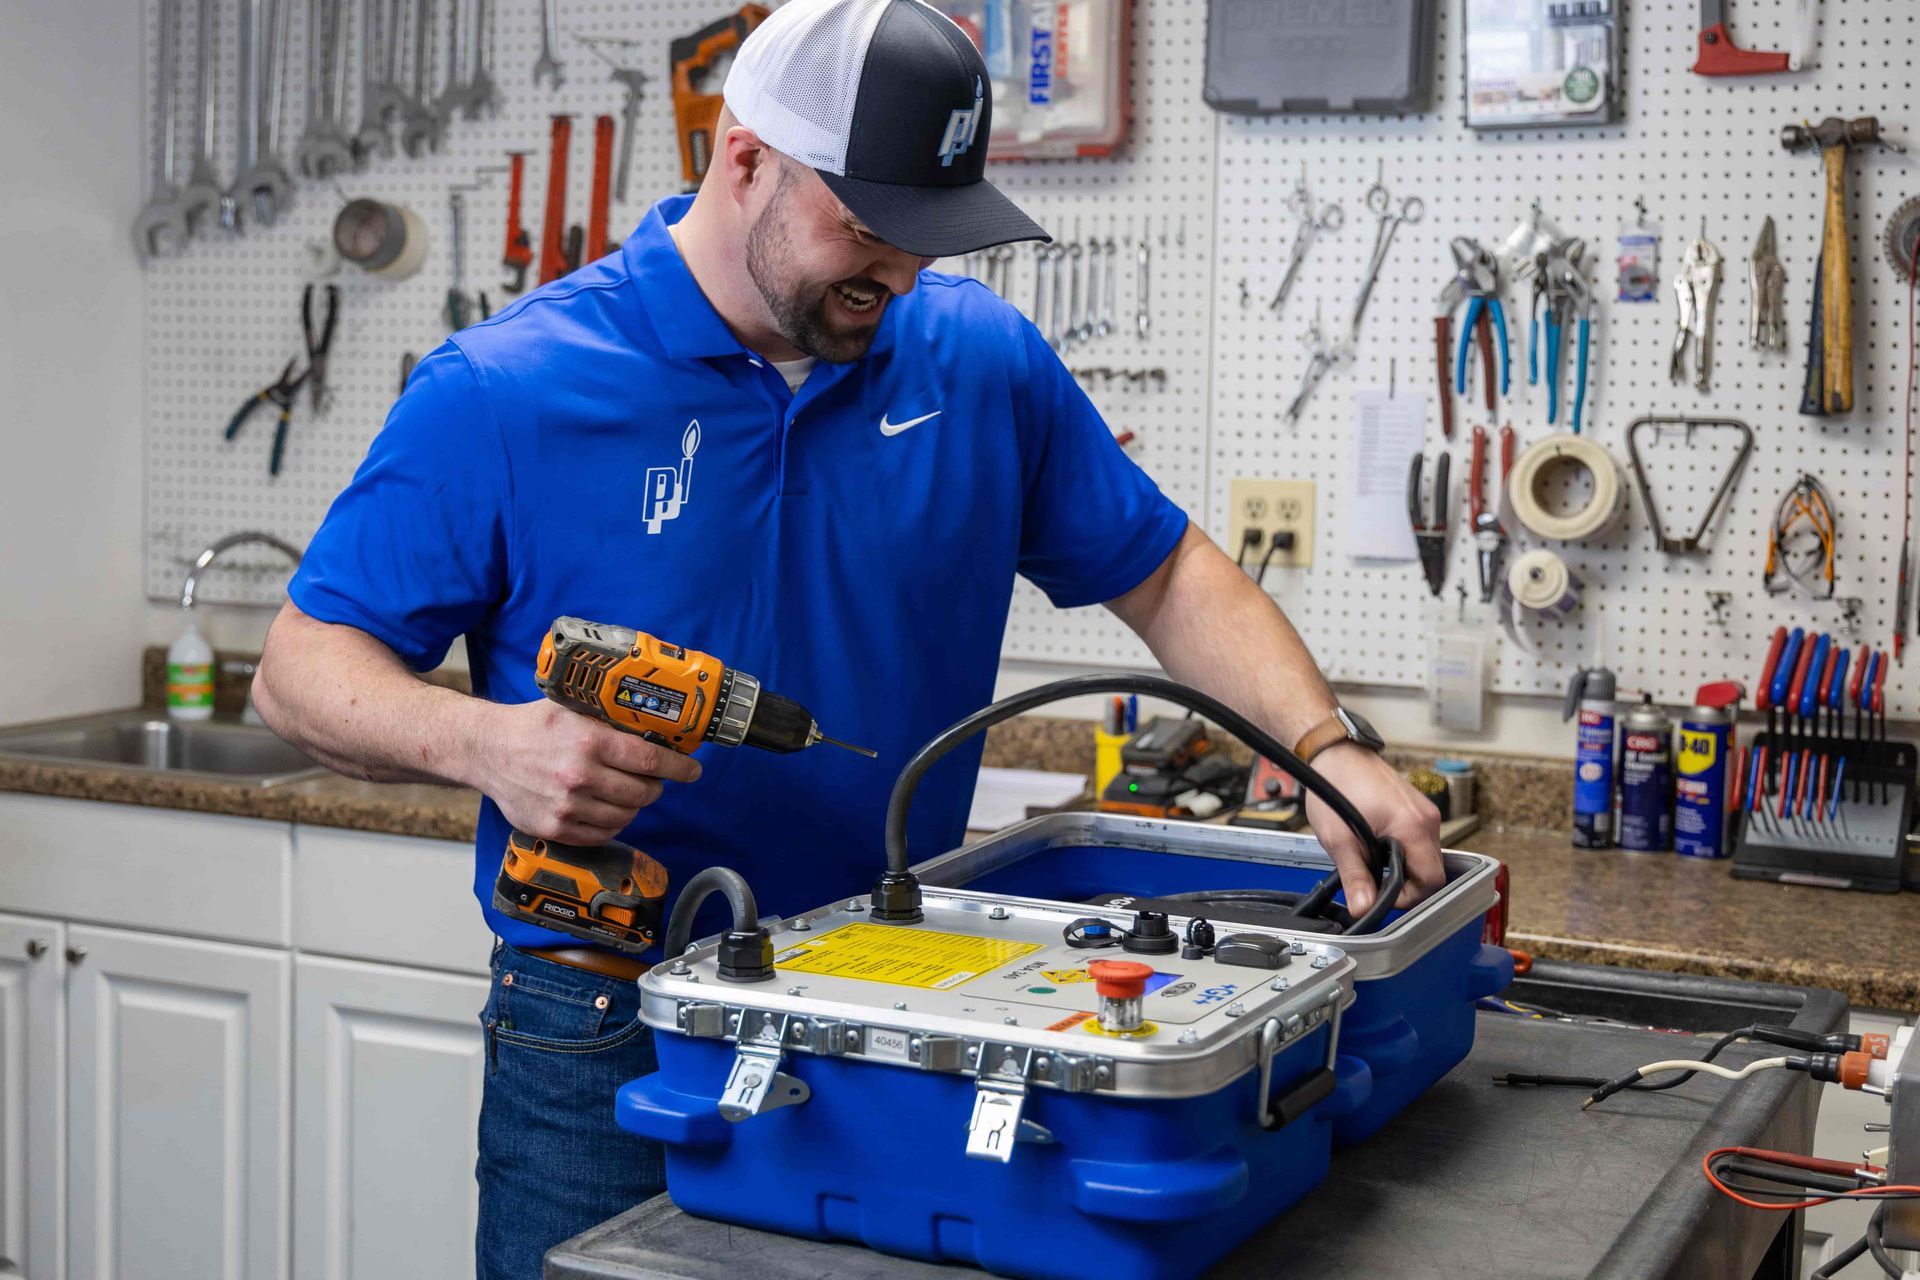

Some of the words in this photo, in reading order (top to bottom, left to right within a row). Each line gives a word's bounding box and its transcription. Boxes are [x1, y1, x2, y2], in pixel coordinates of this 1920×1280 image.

[1031, 27, 1051, 105] FIRST
[1627, 737, 1658, 750] CRC
[543, 903, 576, 918] RIDGID
[874, 1036, 904, 1050] 40456
